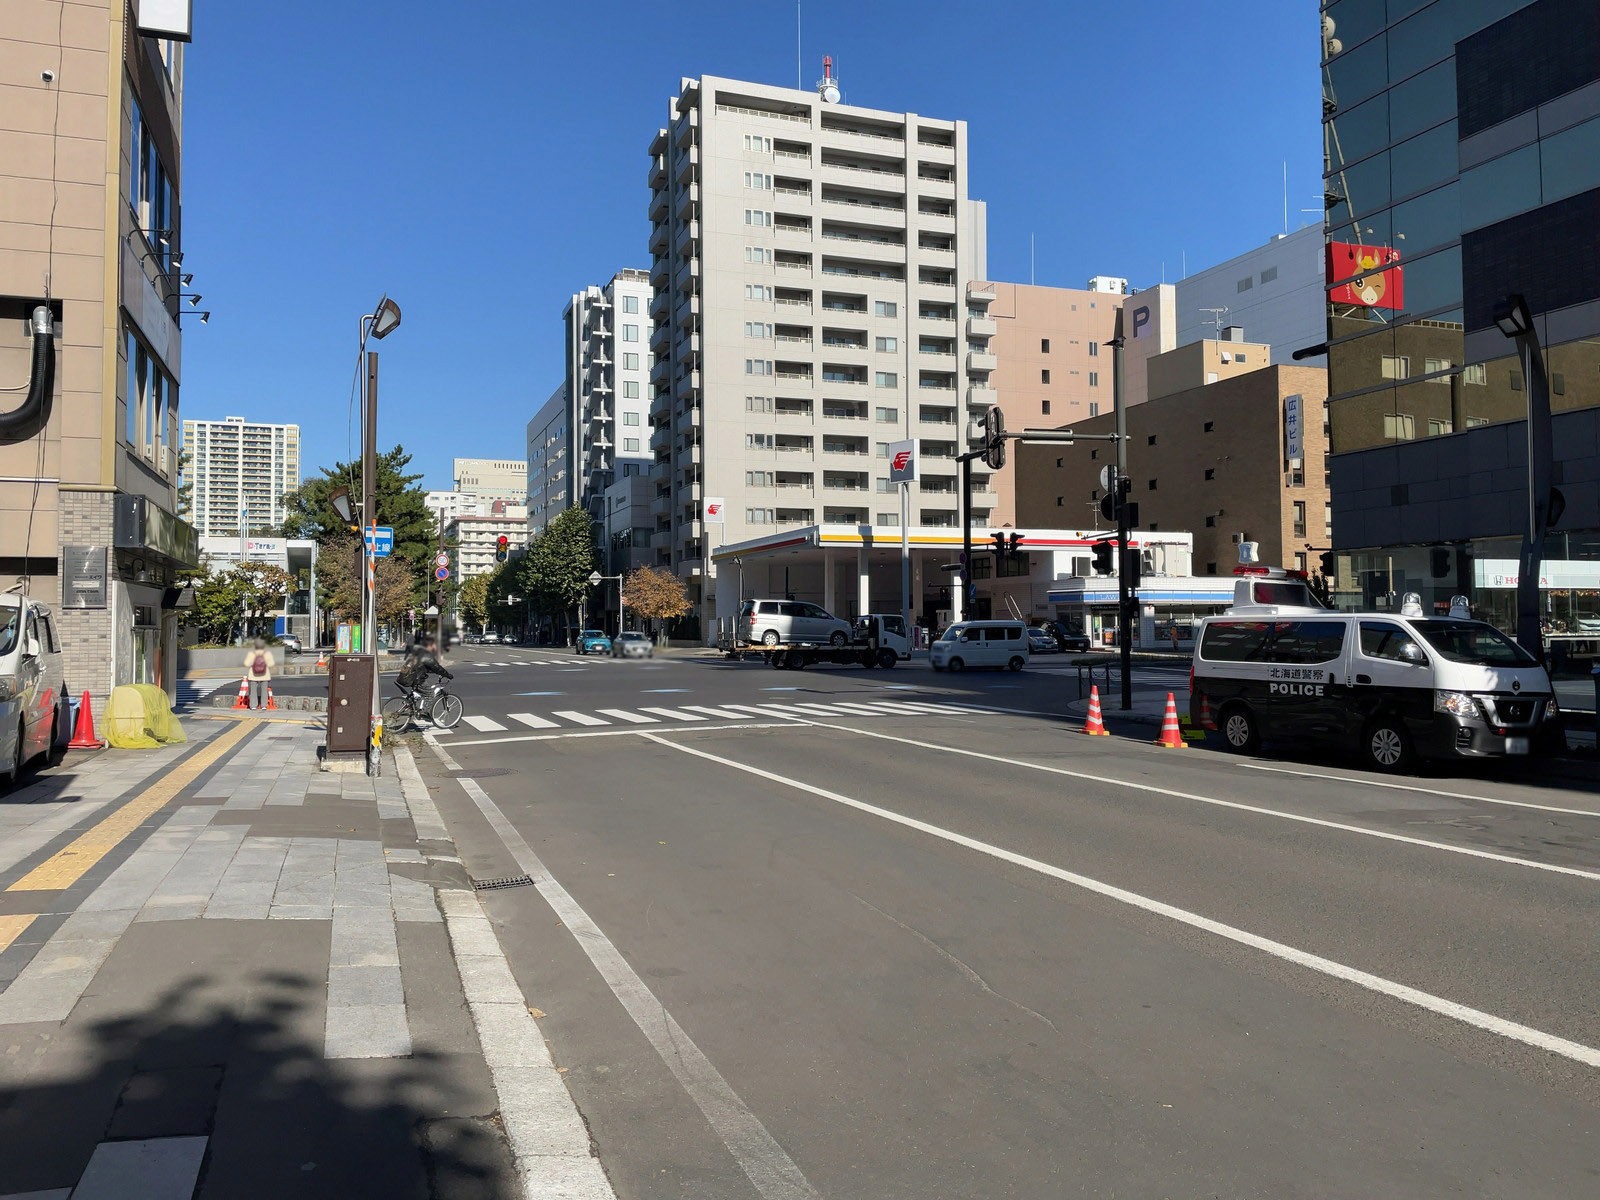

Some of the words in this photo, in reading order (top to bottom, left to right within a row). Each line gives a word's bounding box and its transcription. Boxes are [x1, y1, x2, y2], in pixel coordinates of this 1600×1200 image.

[1133, 305, 1150, 338] P
[1288, 400, 1298, 455] 広井ビル
[1505, 577, 1548, 585] HOA
[1270, 667, 1324, 680] 北海道警察
[1269, 683, 1324, 697] POLICE
